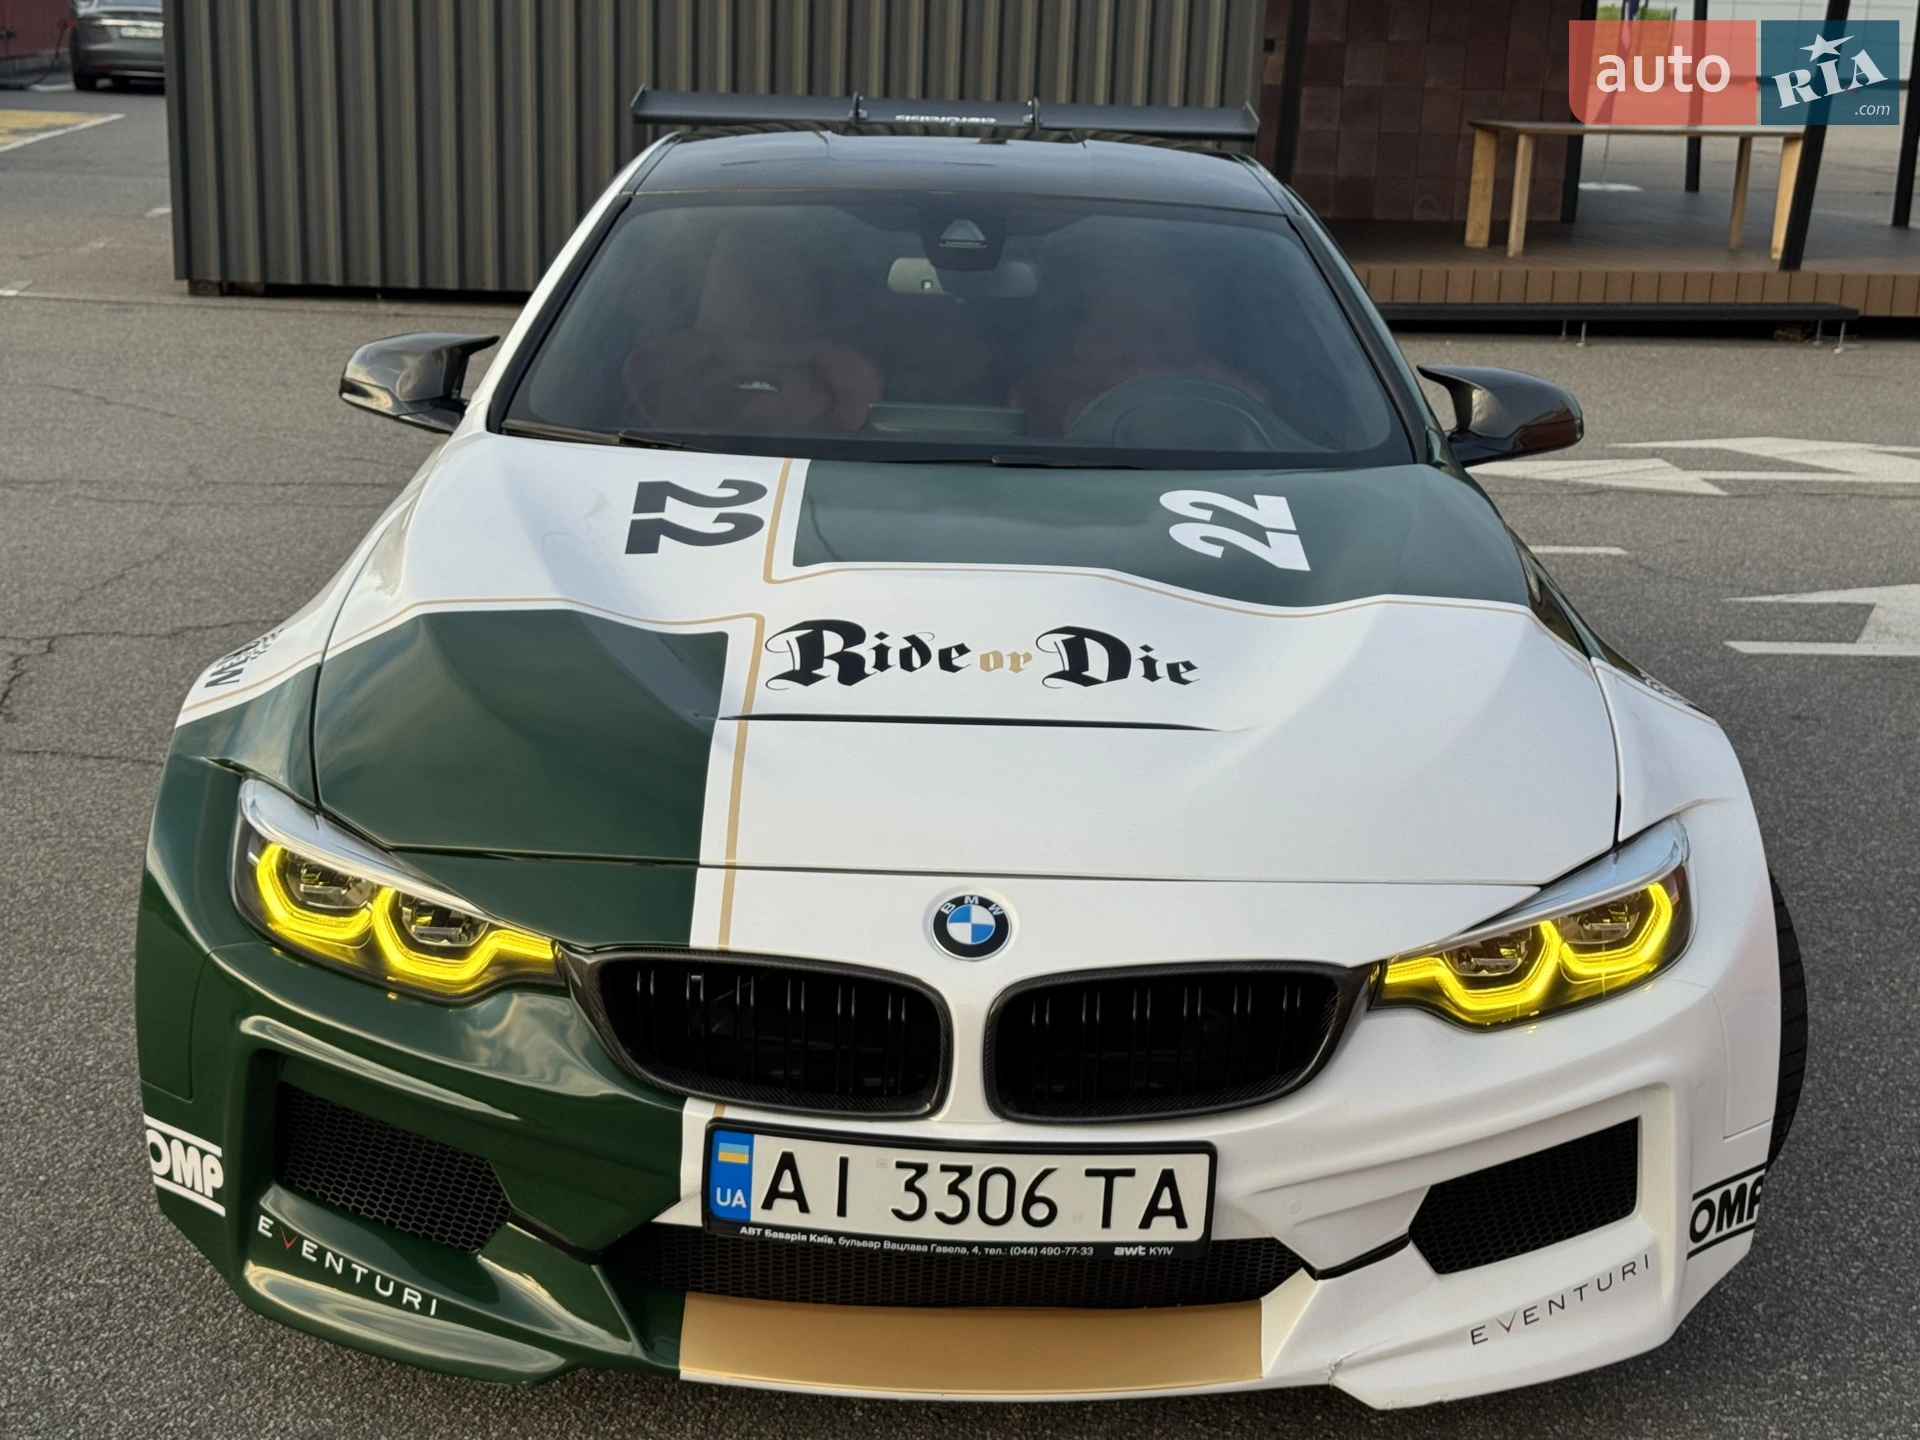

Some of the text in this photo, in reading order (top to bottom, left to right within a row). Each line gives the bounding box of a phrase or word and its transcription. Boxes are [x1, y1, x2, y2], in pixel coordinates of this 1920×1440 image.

[625, 479, 768, 555] 22
[1159, 490, 1311, 571] 22
[765, 619, 1200, 690] Ride or Die
[940, 895, 1004, 916] BMW
[146, 1128, 225, 1199] OMP
[716, 1186, 747, 1210] UA
[891, 1160, 1059, 1228] 3306
[1084, 1168, 1189, 1230] TA
[257, 1214, 438, 1316] EVENTURI
[764, 1229, 808, 1242] Баварія
[838, 1236, 881, 1250] бульвар
[883, 1240, 928, 1253] Вацлава
[1009, 1246, 1038, 1257] (044)
[1039, 1247, 1094, 1257] 490-77-33
[1114, 1244, 1174, 1257] awt KYIV
[1471, 1254, 1649, 1345] EVENTURI
